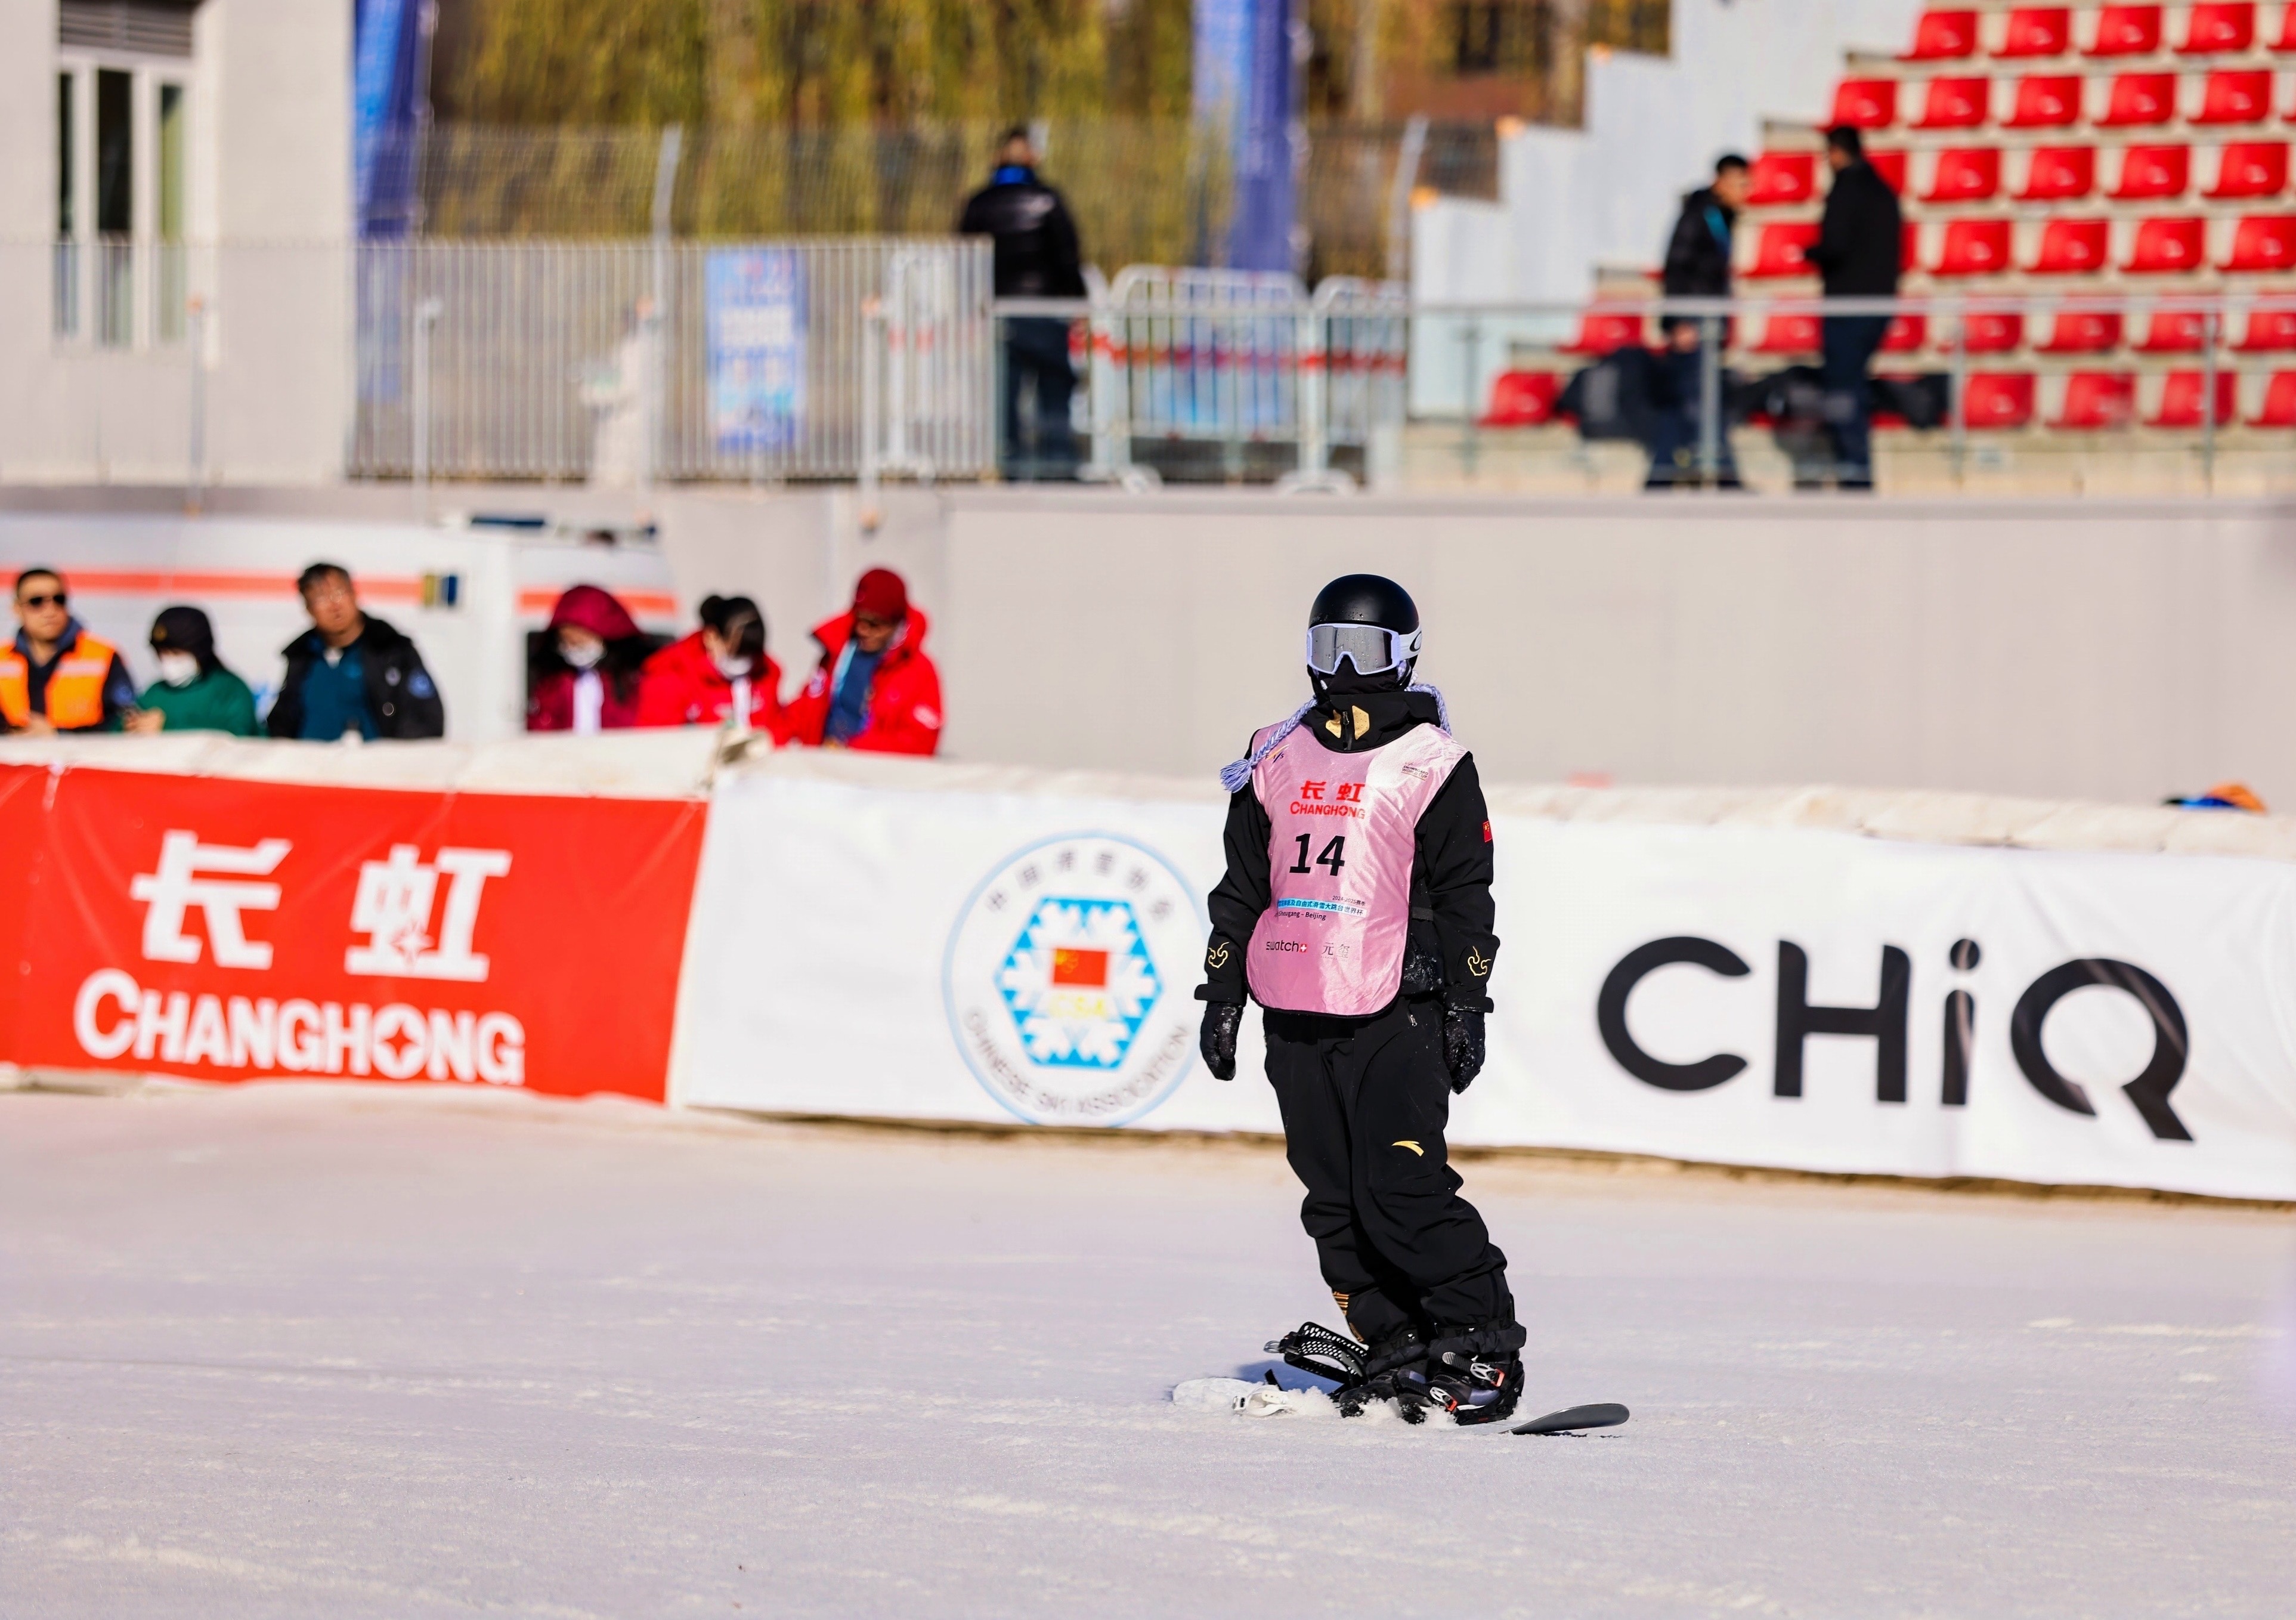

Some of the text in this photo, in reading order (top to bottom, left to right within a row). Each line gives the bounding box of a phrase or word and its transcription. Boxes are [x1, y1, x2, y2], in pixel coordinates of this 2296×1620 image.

[1403, 765, 1429, 775] SNOWBOARD
[1300, 780, 1365, 802] 长虹
[1290, 801, 1366, 820] CHANGHONG
[1289, 833, 1345, 876] 14
[129, 829, 513, 982] 长虹
[1332, 895, 1366, 906] 2024-2025赛季
[1279, 910, 1300, 919] Shougang
[1305, 912, 1326, 920] Beijing
[1266, 940, 1299, 952] swatch
[73, 967, 525, 1086] CHANGHONG
